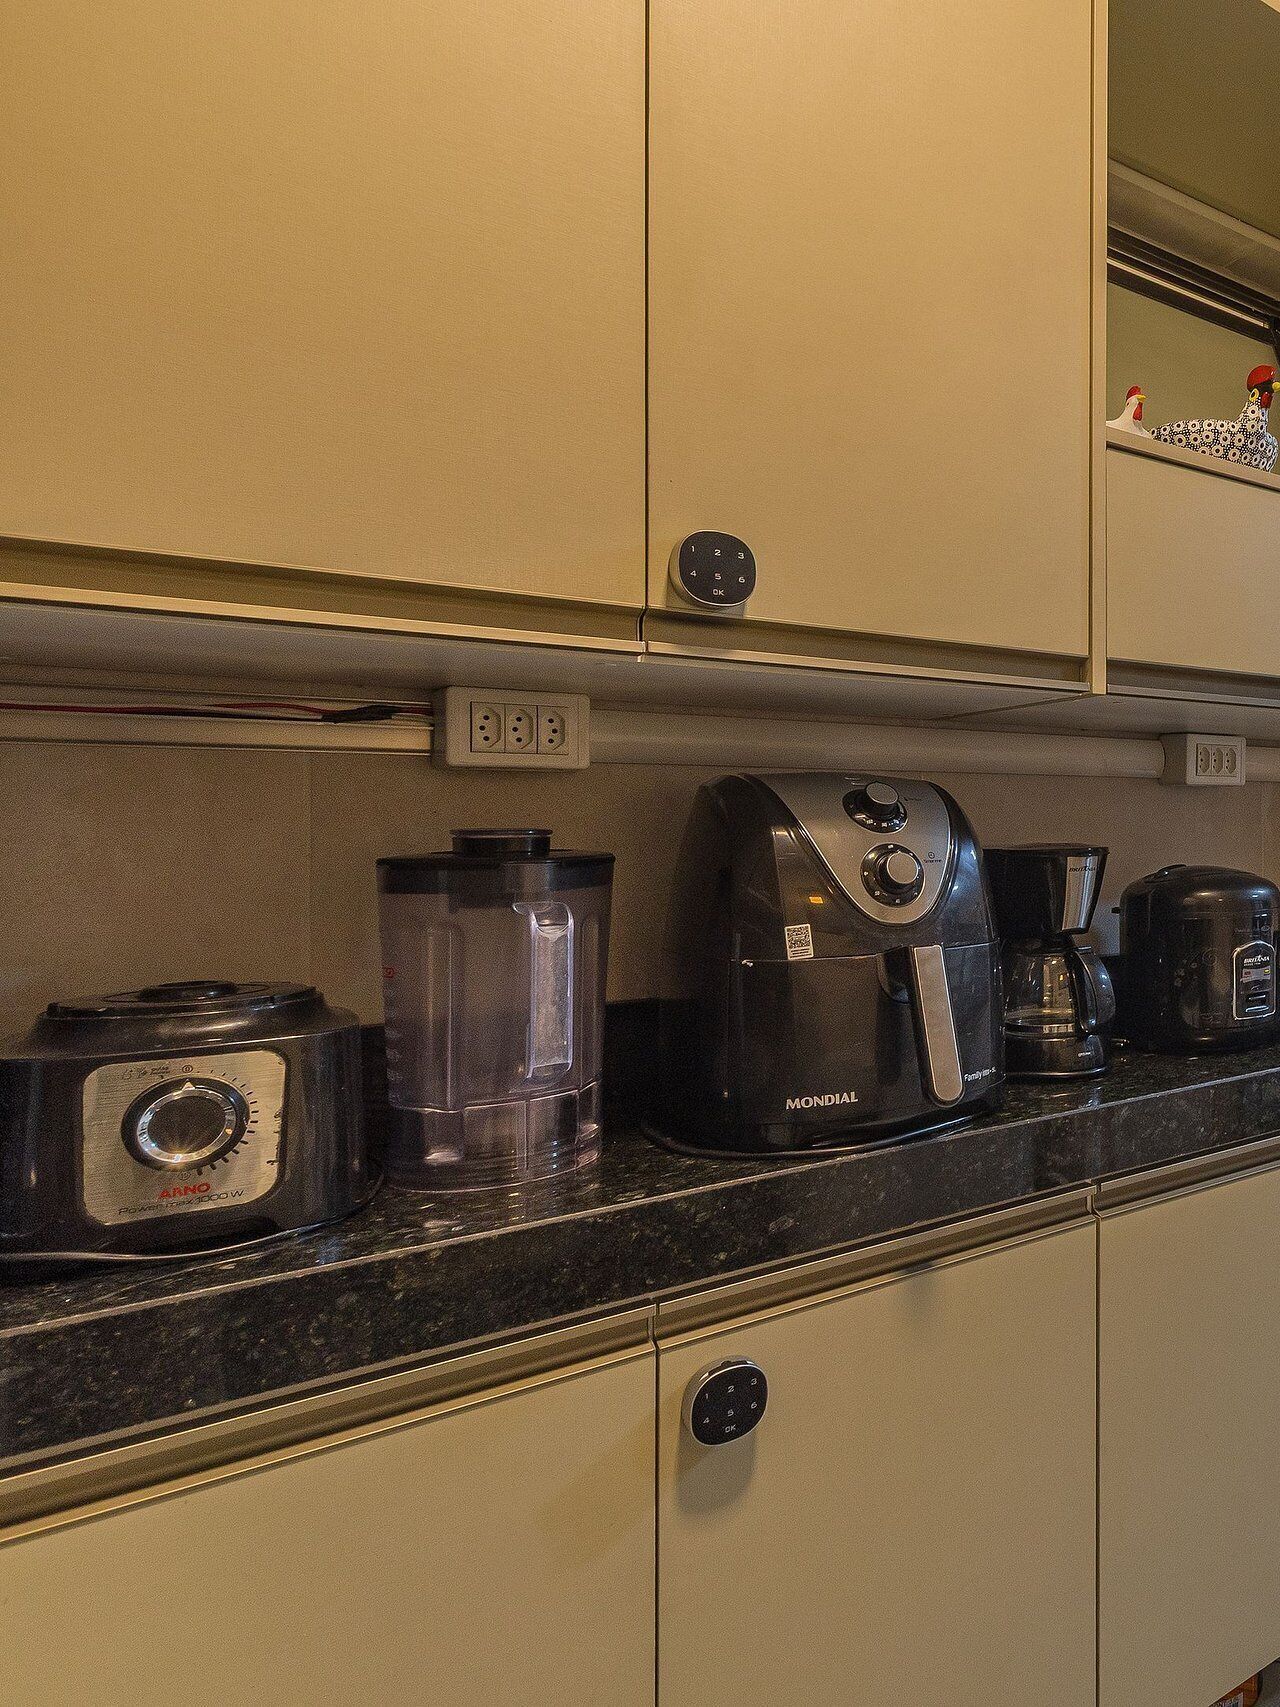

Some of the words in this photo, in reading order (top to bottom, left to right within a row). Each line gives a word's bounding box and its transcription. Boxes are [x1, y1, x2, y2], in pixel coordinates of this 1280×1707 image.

[737, 552, 745, 560] 3
[712, 588, 725, 596] OK
[786, 1091, 859, 1110] MONDIAL
[158, 1182, 211, 1200] ARNO
[231, 1190, 244, 1198] W
[727, 1385, 735, 1393] 2
[750, 1378, 757, 1386] 3
[727, 1409, 734, 1417] 5
[724, 1424, 737, 1433] OK
